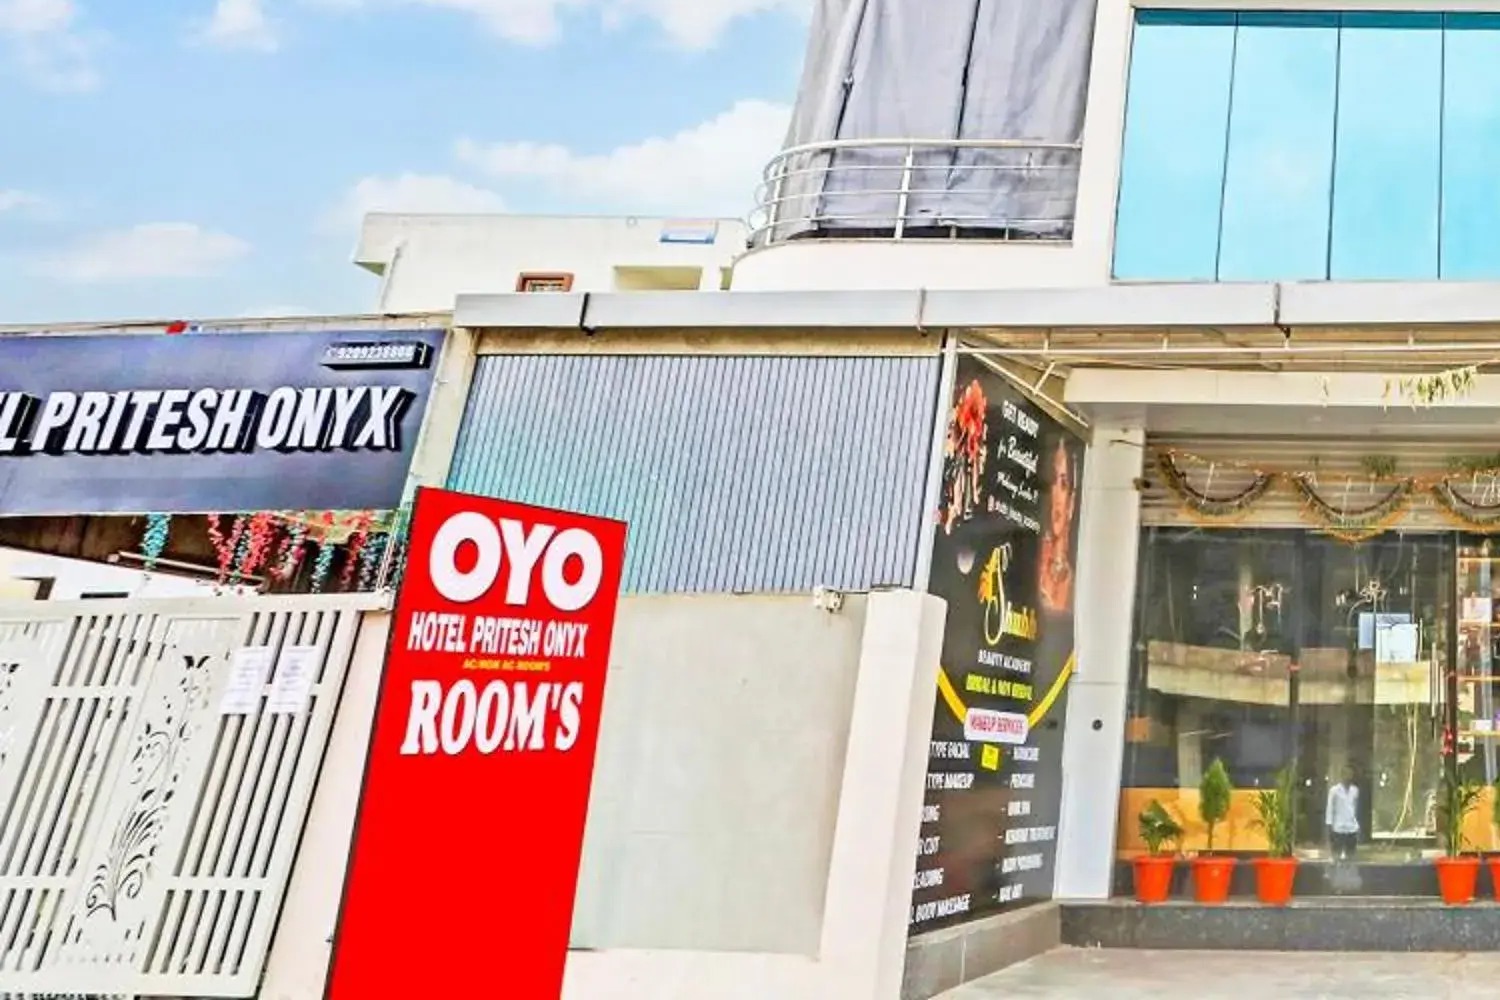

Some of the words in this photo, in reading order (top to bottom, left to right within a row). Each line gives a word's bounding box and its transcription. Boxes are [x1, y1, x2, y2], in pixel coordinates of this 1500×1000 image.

[30, 389, 253, 451] PRITESH
[256, 386, 401, 450] ONYX
[429, 511, 603, 611] OYO
[407, 612, 467, 653] HOTEL
[470, 616, 542, 656] PRITESH
[543, 619, 589, 658] ONYX
[400, 679, 583, 755] ROOM'S
